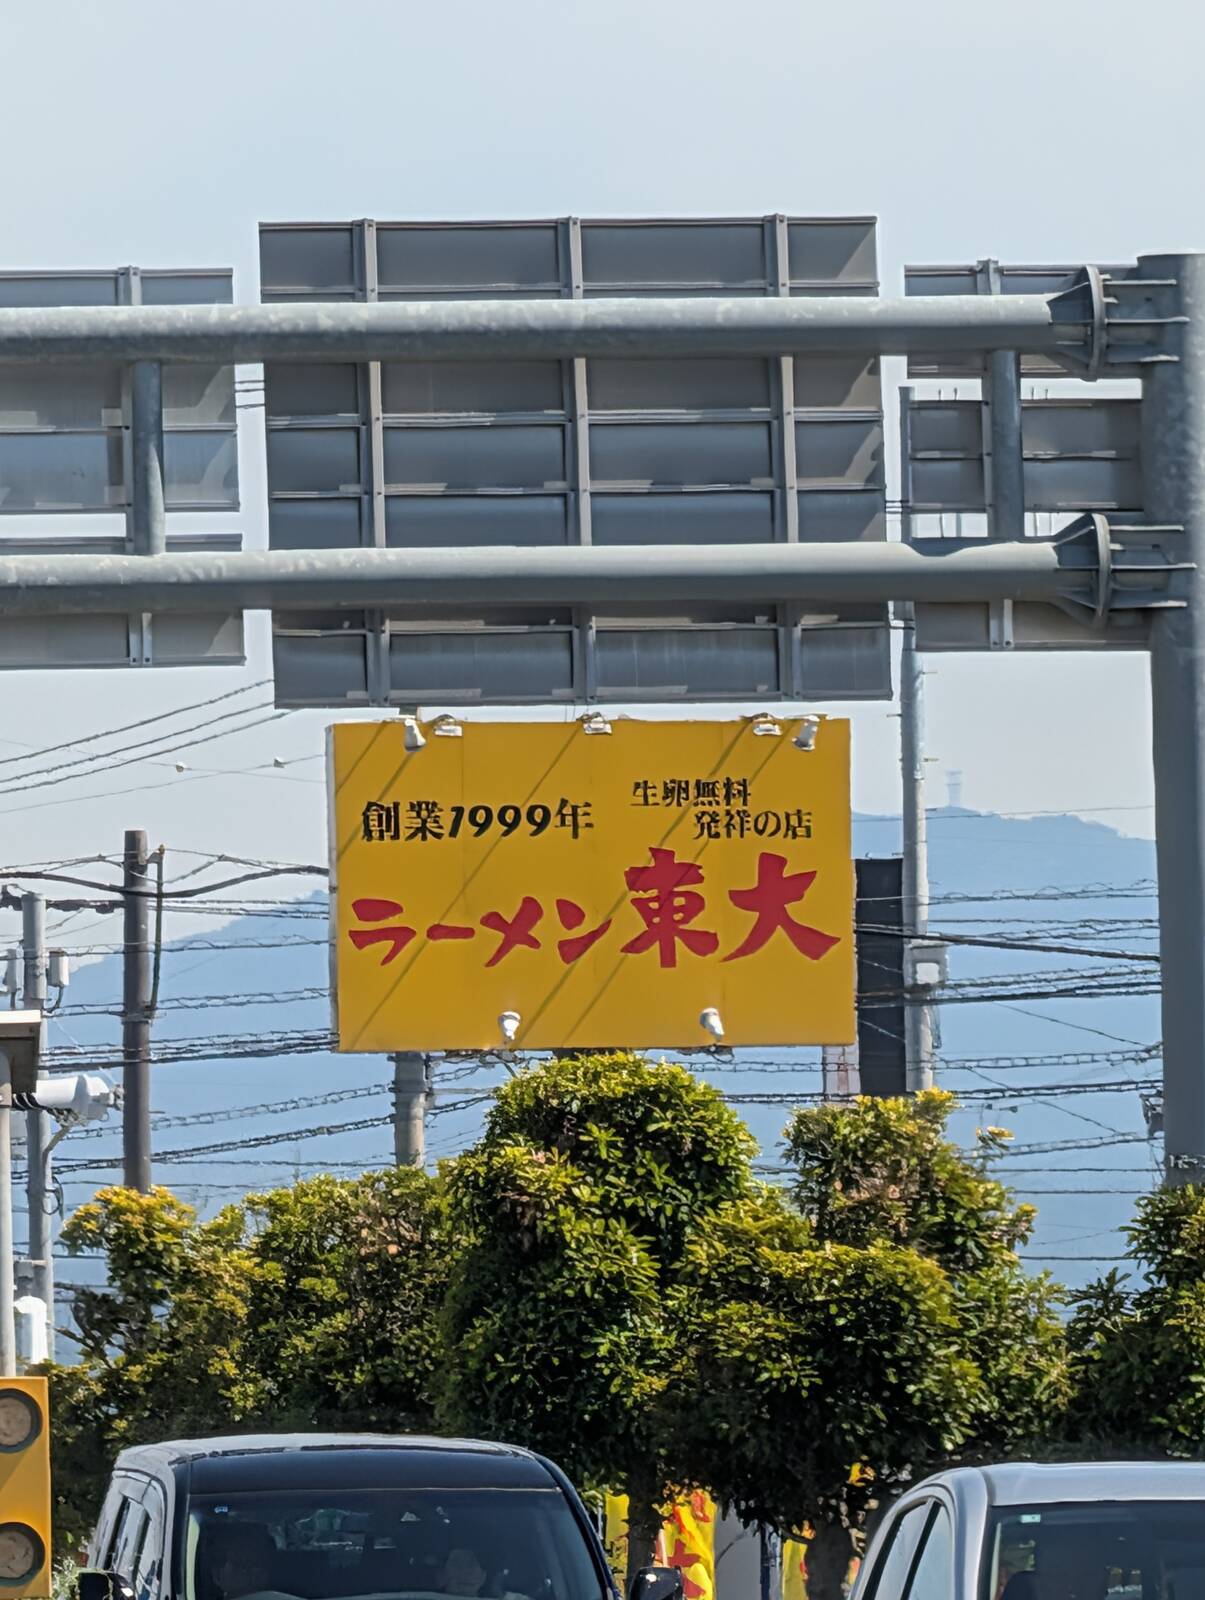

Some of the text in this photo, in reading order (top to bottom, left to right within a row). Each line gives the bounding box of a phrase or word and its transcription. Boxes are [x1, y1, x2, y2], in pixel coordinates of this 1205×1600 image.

[631, 777, 751, 807] 生卵無料
[361, 798, 594, 842] 創業1999年
[693, 809, 812, 840] 発祥の店
